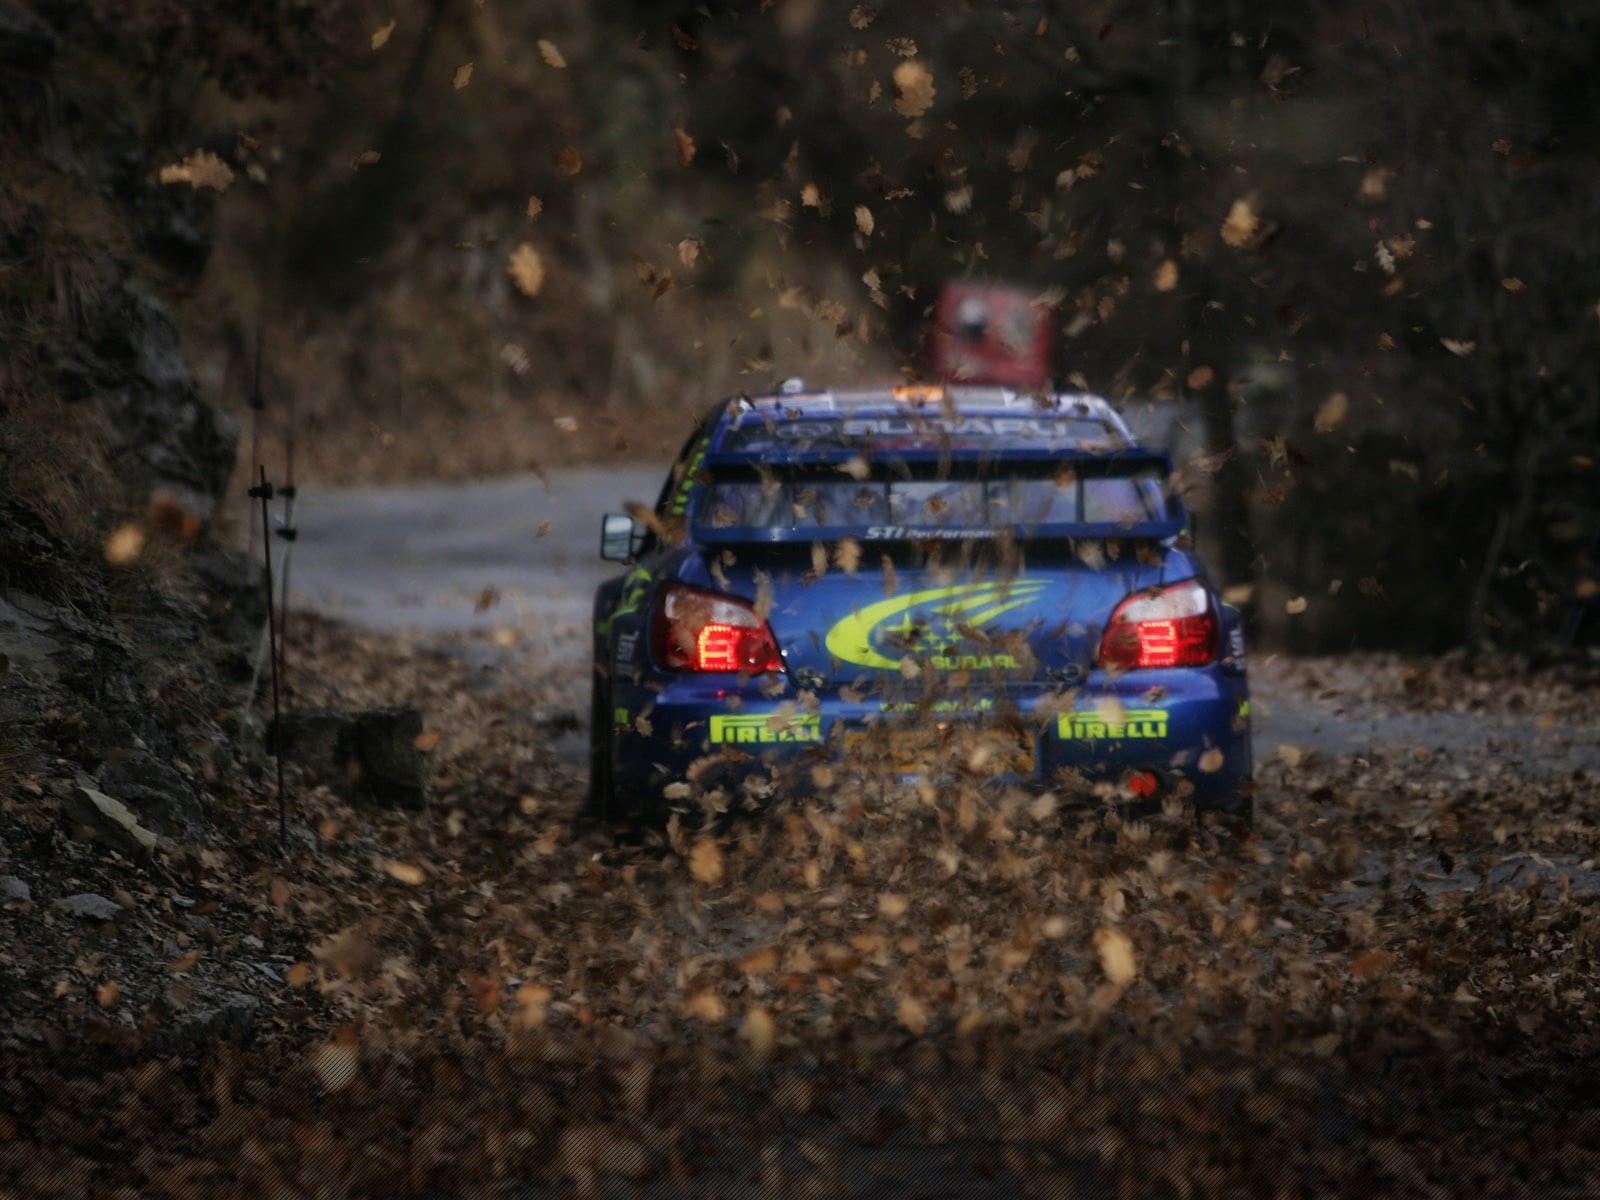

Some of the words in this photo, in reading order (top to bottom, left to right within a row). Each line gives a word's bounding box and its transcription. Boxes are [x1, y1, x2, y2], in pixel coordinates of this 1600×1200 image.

[864, 526, 904, 540] STI
[905, 528, 1010, 540] Performan
[710, 713, 821, 743] PIRELLI
[1057, 709, 1168, 739] PIRELLI
